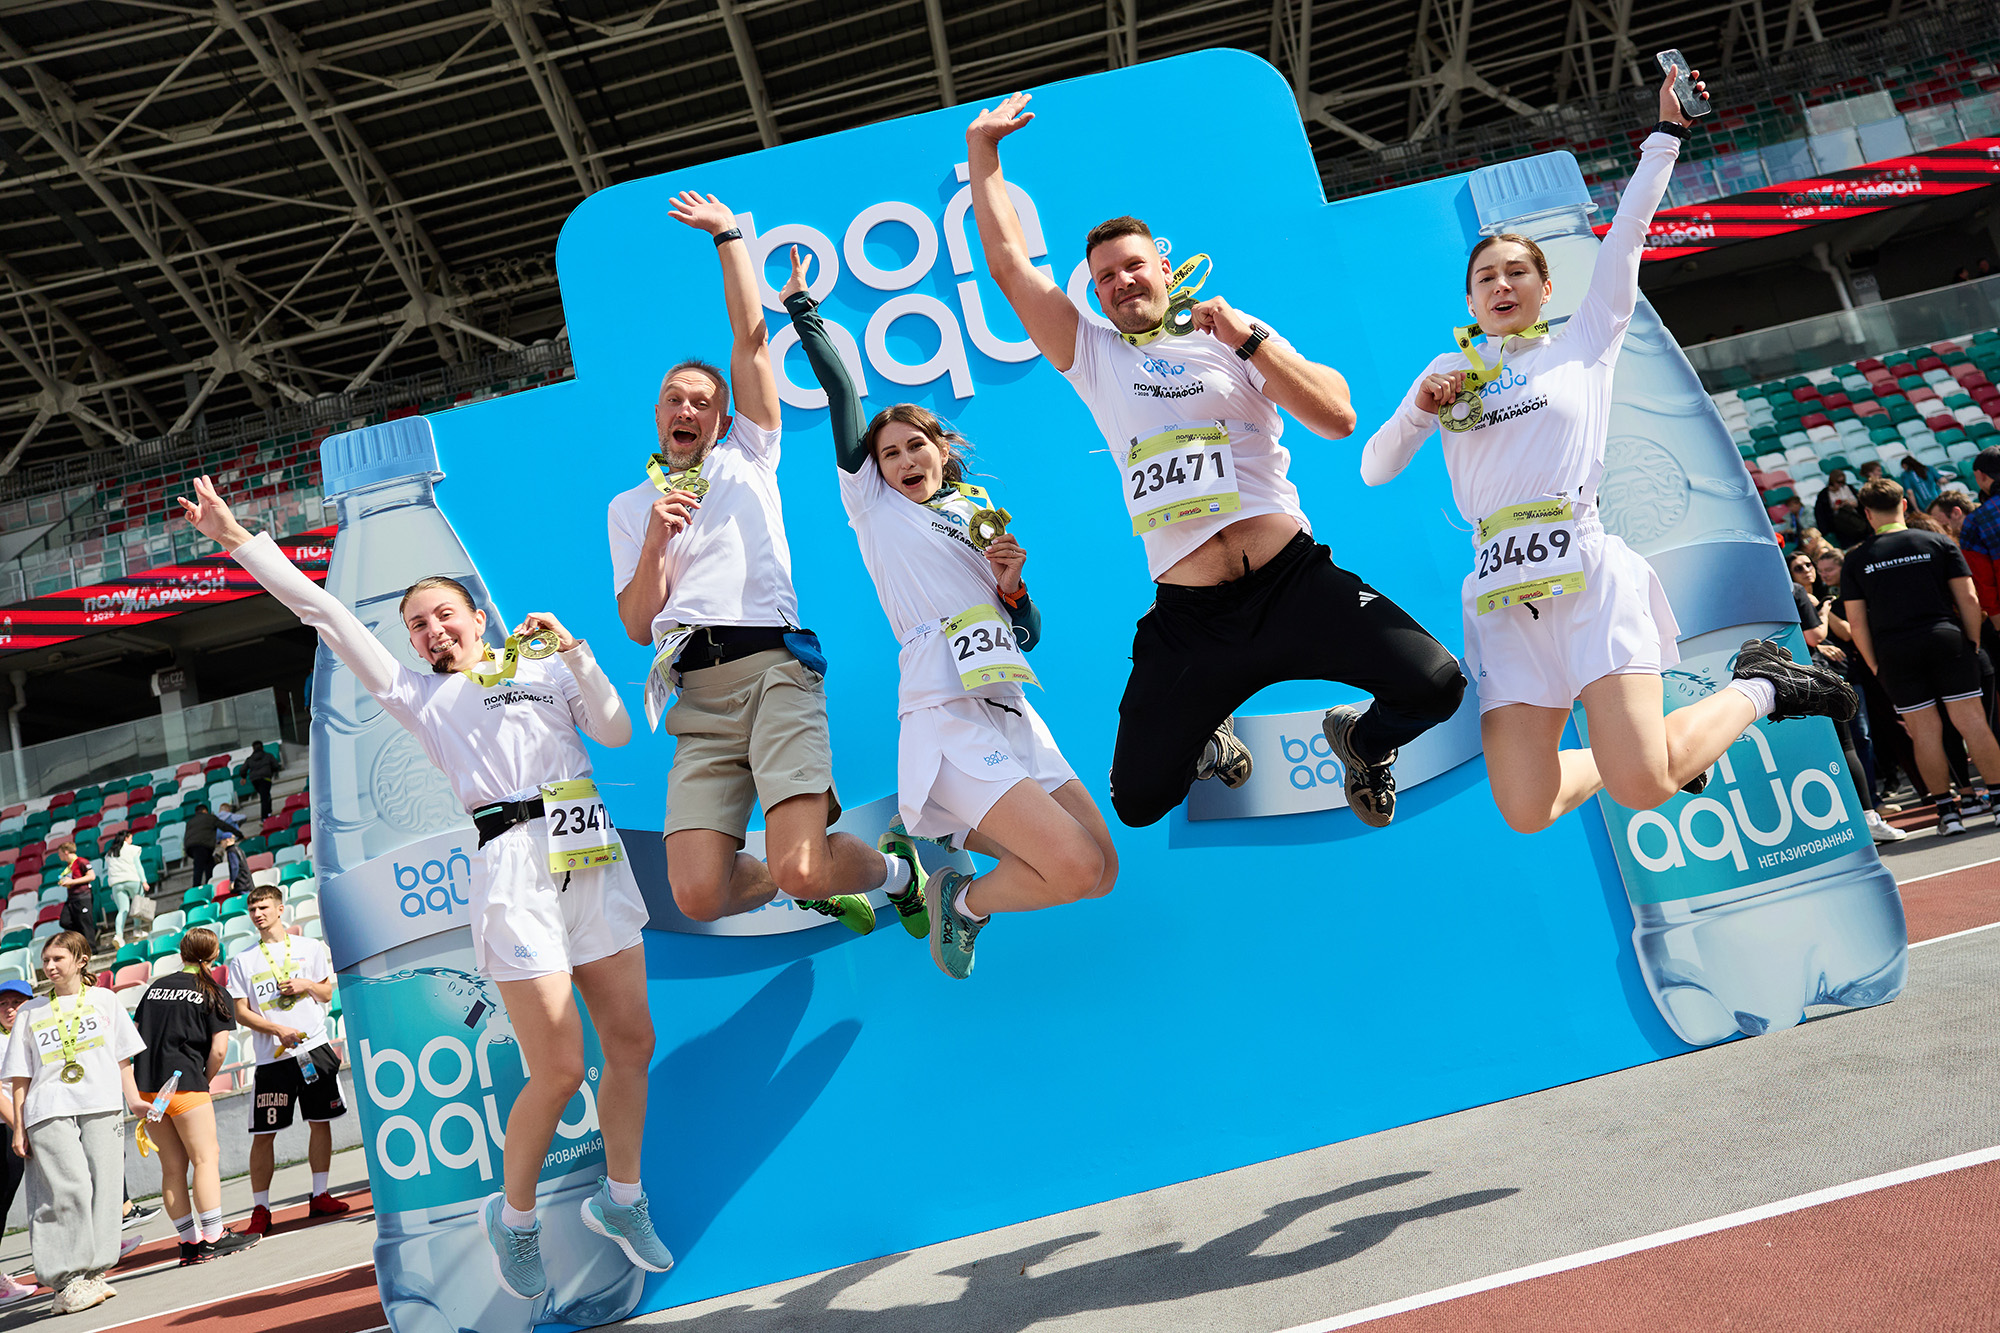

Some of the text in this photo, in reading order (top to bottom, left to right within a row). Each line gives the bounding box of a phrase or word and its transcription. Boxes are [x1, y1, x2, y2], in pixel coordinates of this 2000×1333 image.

[1644, 224, 1715, 250] РАФОН
[1131, 451, 1225, 500] 23471
[1479, 530, 1571, 580] 23469
[1875, 553, 1931, 569] ЦЕНТРОМАШ
[953, 627, 1020, 661] 234
[1280, 733, 1334, 764] bo
[1290, 759, 1346, 790] aq
[1627, 768, 1850, 873] aqua
[1757, 828, 1855, 869] НЕГАЗИРОВАННАЯ
[400, 878, 471, 918] aqu
[943, 914, 953, 944] HOKA
[147, 988, 204, 1005] БЕЛАРУСЬ
[257, 1093, 288, 1108] CHICAGO
[267, 1108, 277, 1125] 8
